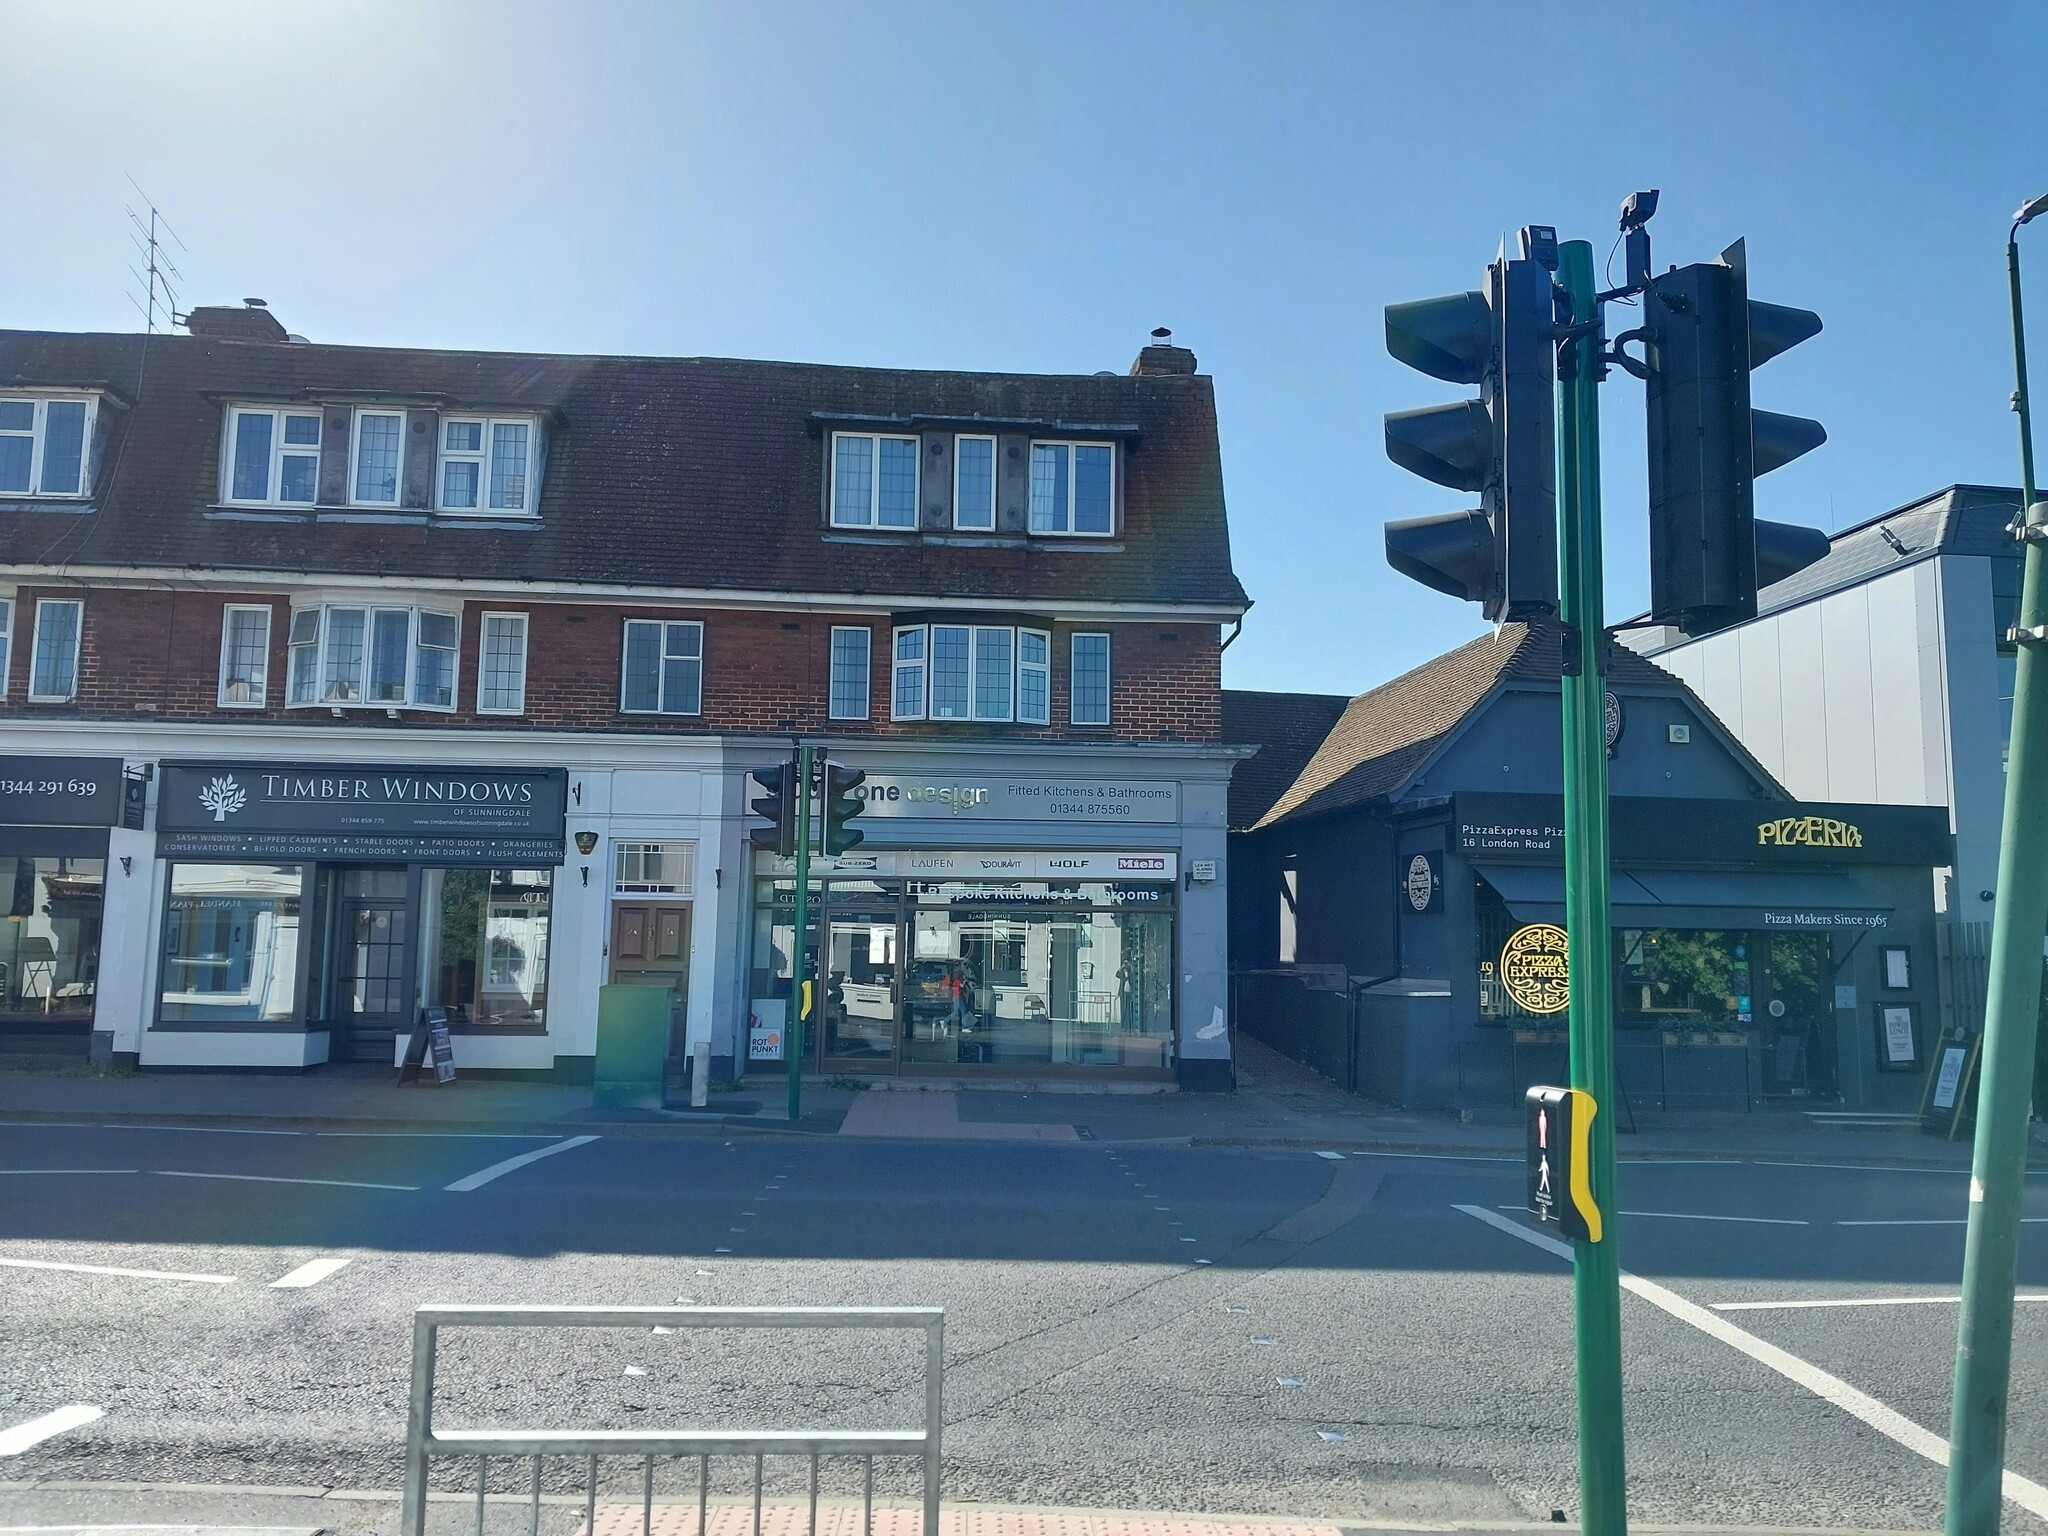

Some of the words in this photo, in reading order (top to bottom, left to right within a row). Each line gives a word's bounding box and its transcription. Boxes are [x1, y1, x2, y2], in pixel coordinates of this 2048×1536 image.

[38, 781, 63, 796] 291
[67, 779, 97, 797] 639
[261, 774, 370, 799] TIMBER
[381, 778, 533, 802] WINDOWS
[1008, 784, 1041, 797] Fitted
[1044, 784, 1094, 797] Kitchens
[1097, 785, 1106, 798] &
[1108, 786, 1172, 799] Bathrooms
[854, 785, 900, 802] one
[907, 782, 990, 814] design
[453, 808, 466, 816] OF
[468, 808, 531, 817] SUNNINGDALE
[1049, 803, 1084, 815] 01344
[1087, 804, 1130, 816] 875560
[1462, 824, 1538, 838] PizzaExpress
[1544, 827, 1566, 837] Piz
[1757, 816, 1864, 849] PIZZERIA
[176, 834, 198, 843] SASH
[200, 834, 242, 843] WINDOWS
[259, 836, 287, 844] LIPPED
[289, 836, 338, 845] CASEMENTS
[355, 838, 385, 846] STABLE
[386, 838, 414, 846] DOORS
[432, 839, 456, 847] PATIO
[458, 839, 486, 848] DOORS
[503, 840, 553, 849] ORANGERIES
[1463, 838, 1476, 847] 16
[1481, 839, 1520, 849] London
[1525, 840, 1551, 849] Road
[164, 844, 236, 852] CONSERVATORIES
[254, 846, 282, 854] BI-FOLD
[284, 846, 317, 854] DOORS
[334, 847, 367, 855] FRENCH
[369, 847, 397, 856] DOORS
[414, 848, 442, 857] FRONT
[443, 848, 471, 857] DOORS
[488, 850, 514, 858] FLUSH
[515, 850, 564, 859] CASEMENTS
[911, 858, 954, 868] LAUFEN
[1049, 859, 1090, 868] WOLF
[1118, 858, 1164, 869] Miele
[1062, 889, 1072, 900] &
[1764, 912, 1792, 925] Pizza
[1794, 912, 1832, 925] Makers
[1834, 913, 1863, 926] Since
[1865, 915, 1888, 928] 1965
[1480, 961, 1494, 975] 19
[1522, 955, 1564, 967] PIZZA
[1510, 966, 1569, 978] EXPRES
